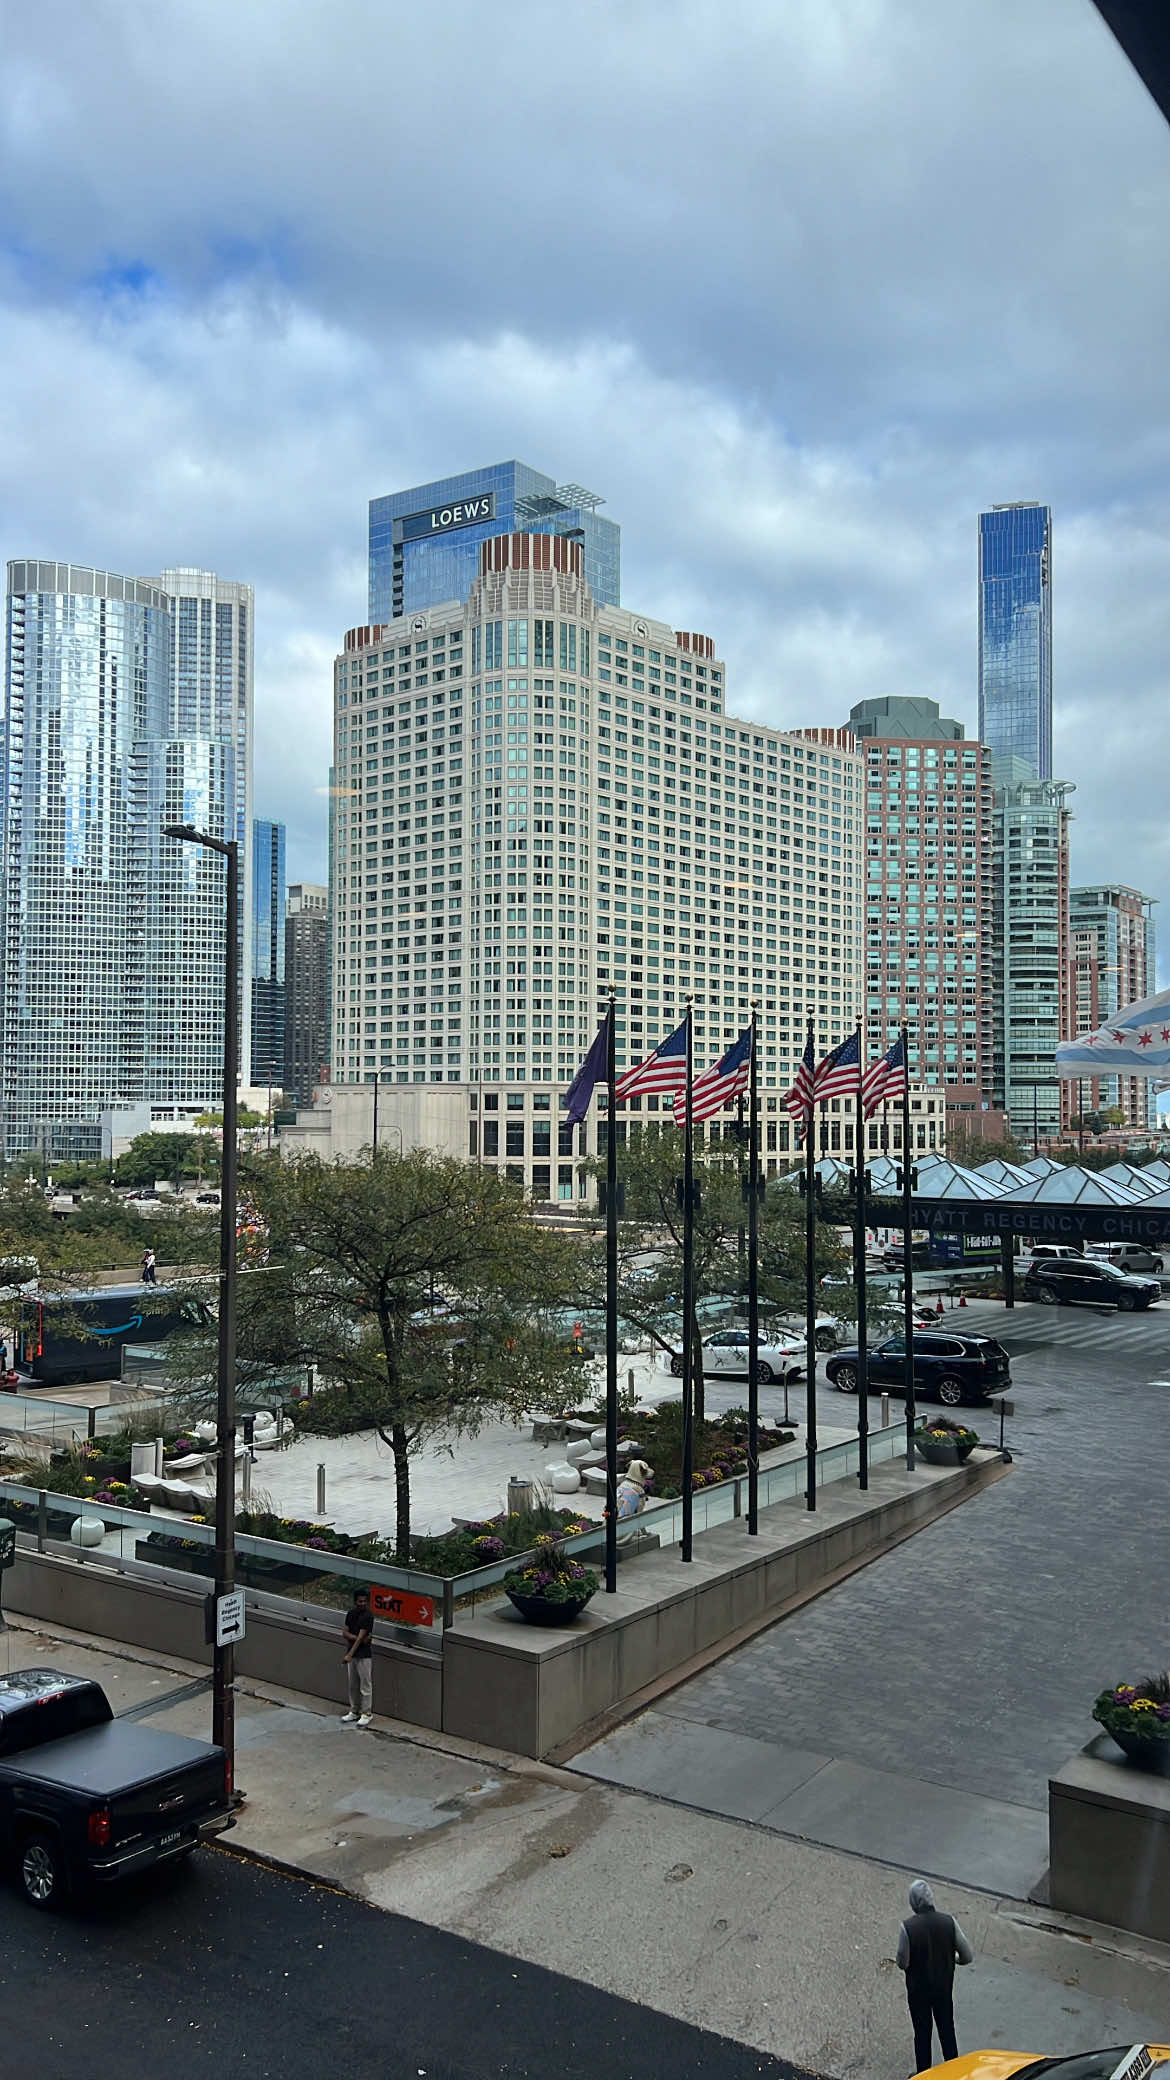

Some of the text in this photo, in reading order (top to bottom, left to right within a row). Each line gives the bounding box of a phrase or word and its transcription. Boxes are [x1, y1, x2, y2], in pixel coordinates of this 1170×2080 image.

[431, 499, 489, 528] LOEWS
[911, 1209, 969, 1225] HYATT
[983, 1212, 1087, 1231] REGENCY
